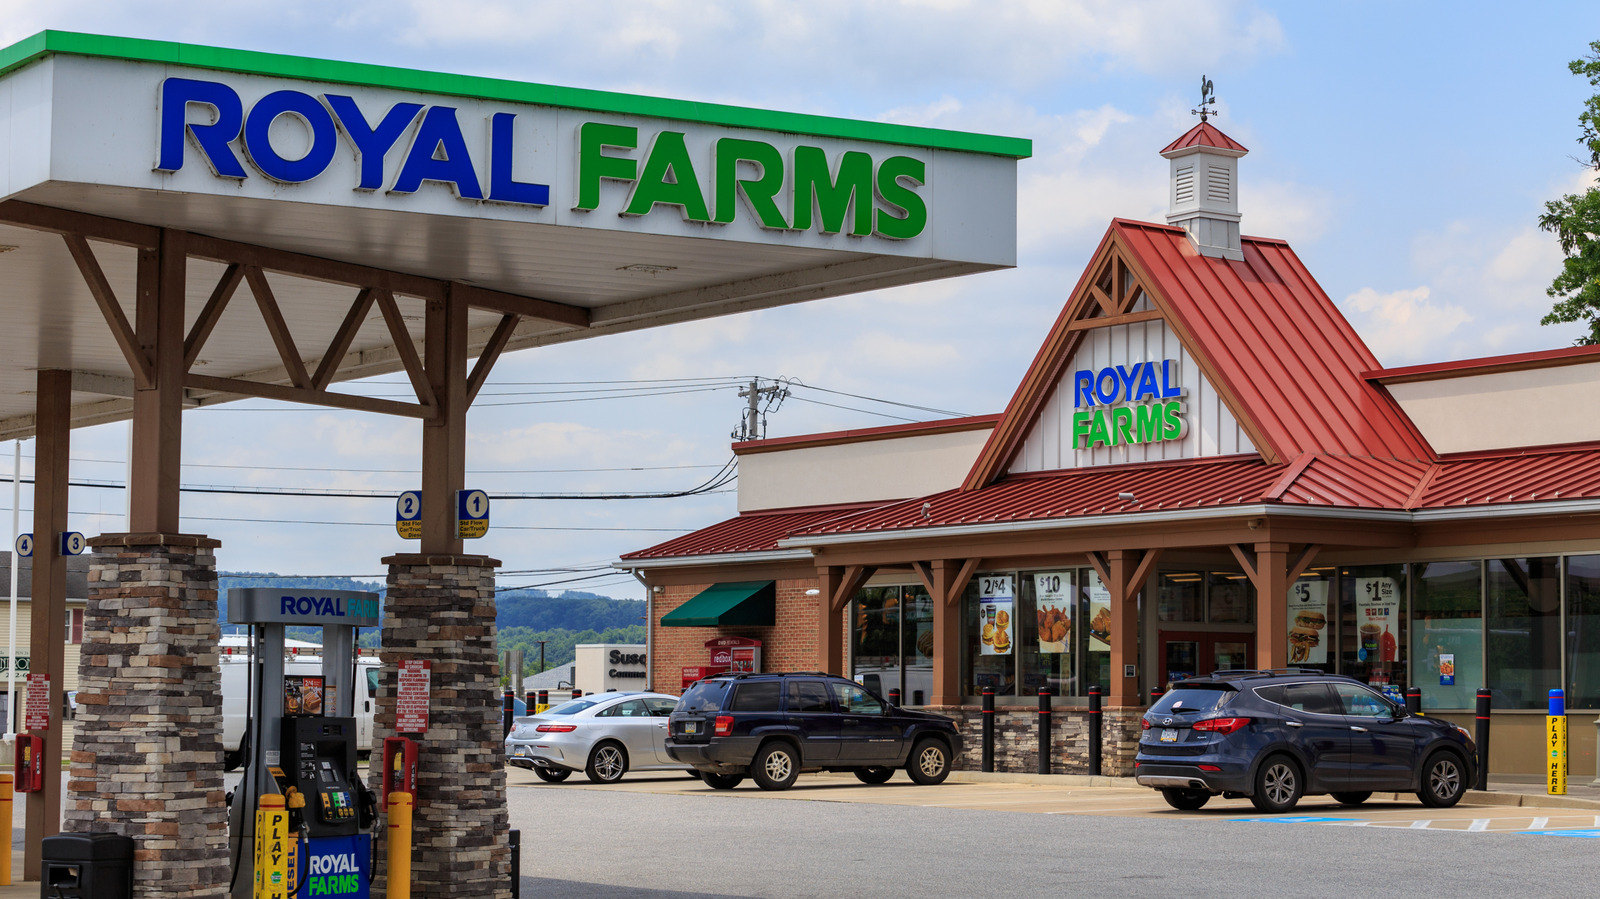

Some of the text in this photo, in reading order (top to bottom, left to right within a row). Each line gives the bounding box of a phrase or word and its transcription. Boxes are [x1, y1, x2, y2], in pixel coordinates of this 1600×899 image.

[153, 77, 927, 240] ROYAL FARMS
[1074, 359, 1186, 409] ROYAL
[1072, 401, 1187, 450] FARMS
[404, 497, 413, 513] 2
[473, 496, 480, 512] 1
[21, 539, 28, 551] 4
[72, 537, 79, 550] 3
[984, 578, 1006, 595] 2/$4
[1039, 575, 1060, 594] $10
[1295, 583, 1310, 602] $5
[1365, 580, 1382, 602] $1
[1381, 588, 1393, 596] Size
[281, 596, 345, 616] ROYAL
[714, 654, 731, 663] redbox
[271, 815, 282, 866] PLAY
[287, 846, 295, 899] ESEL
[309, 853, 359, 875] ROYAL
[309, 874, 359, 896] FARMS
